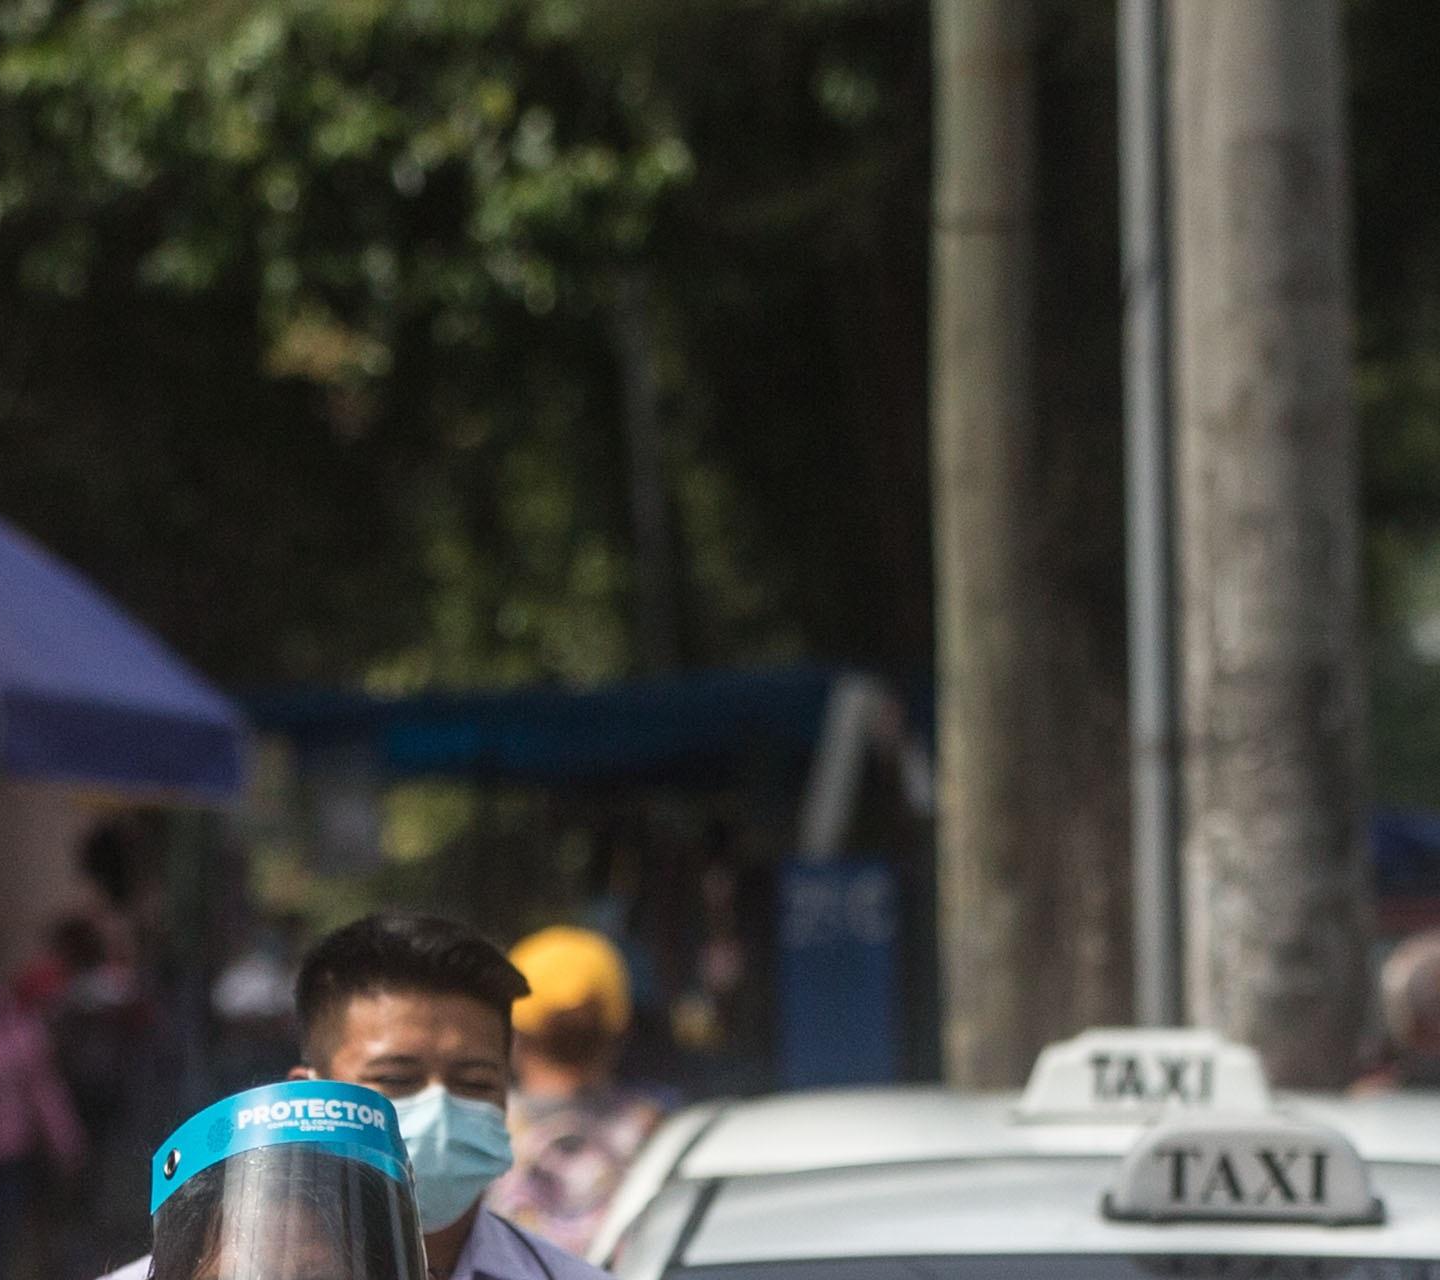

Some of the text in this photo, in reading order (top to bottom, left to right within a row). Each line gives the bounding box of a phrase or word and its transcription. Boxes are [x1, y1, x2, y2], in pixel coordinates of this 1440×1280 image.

[1090, 1050, 1214, 1104] TAXI
[238, 1099, 386, 1131] PROTECTOR
[1156, 1149, 1331, 1205] TAXI
